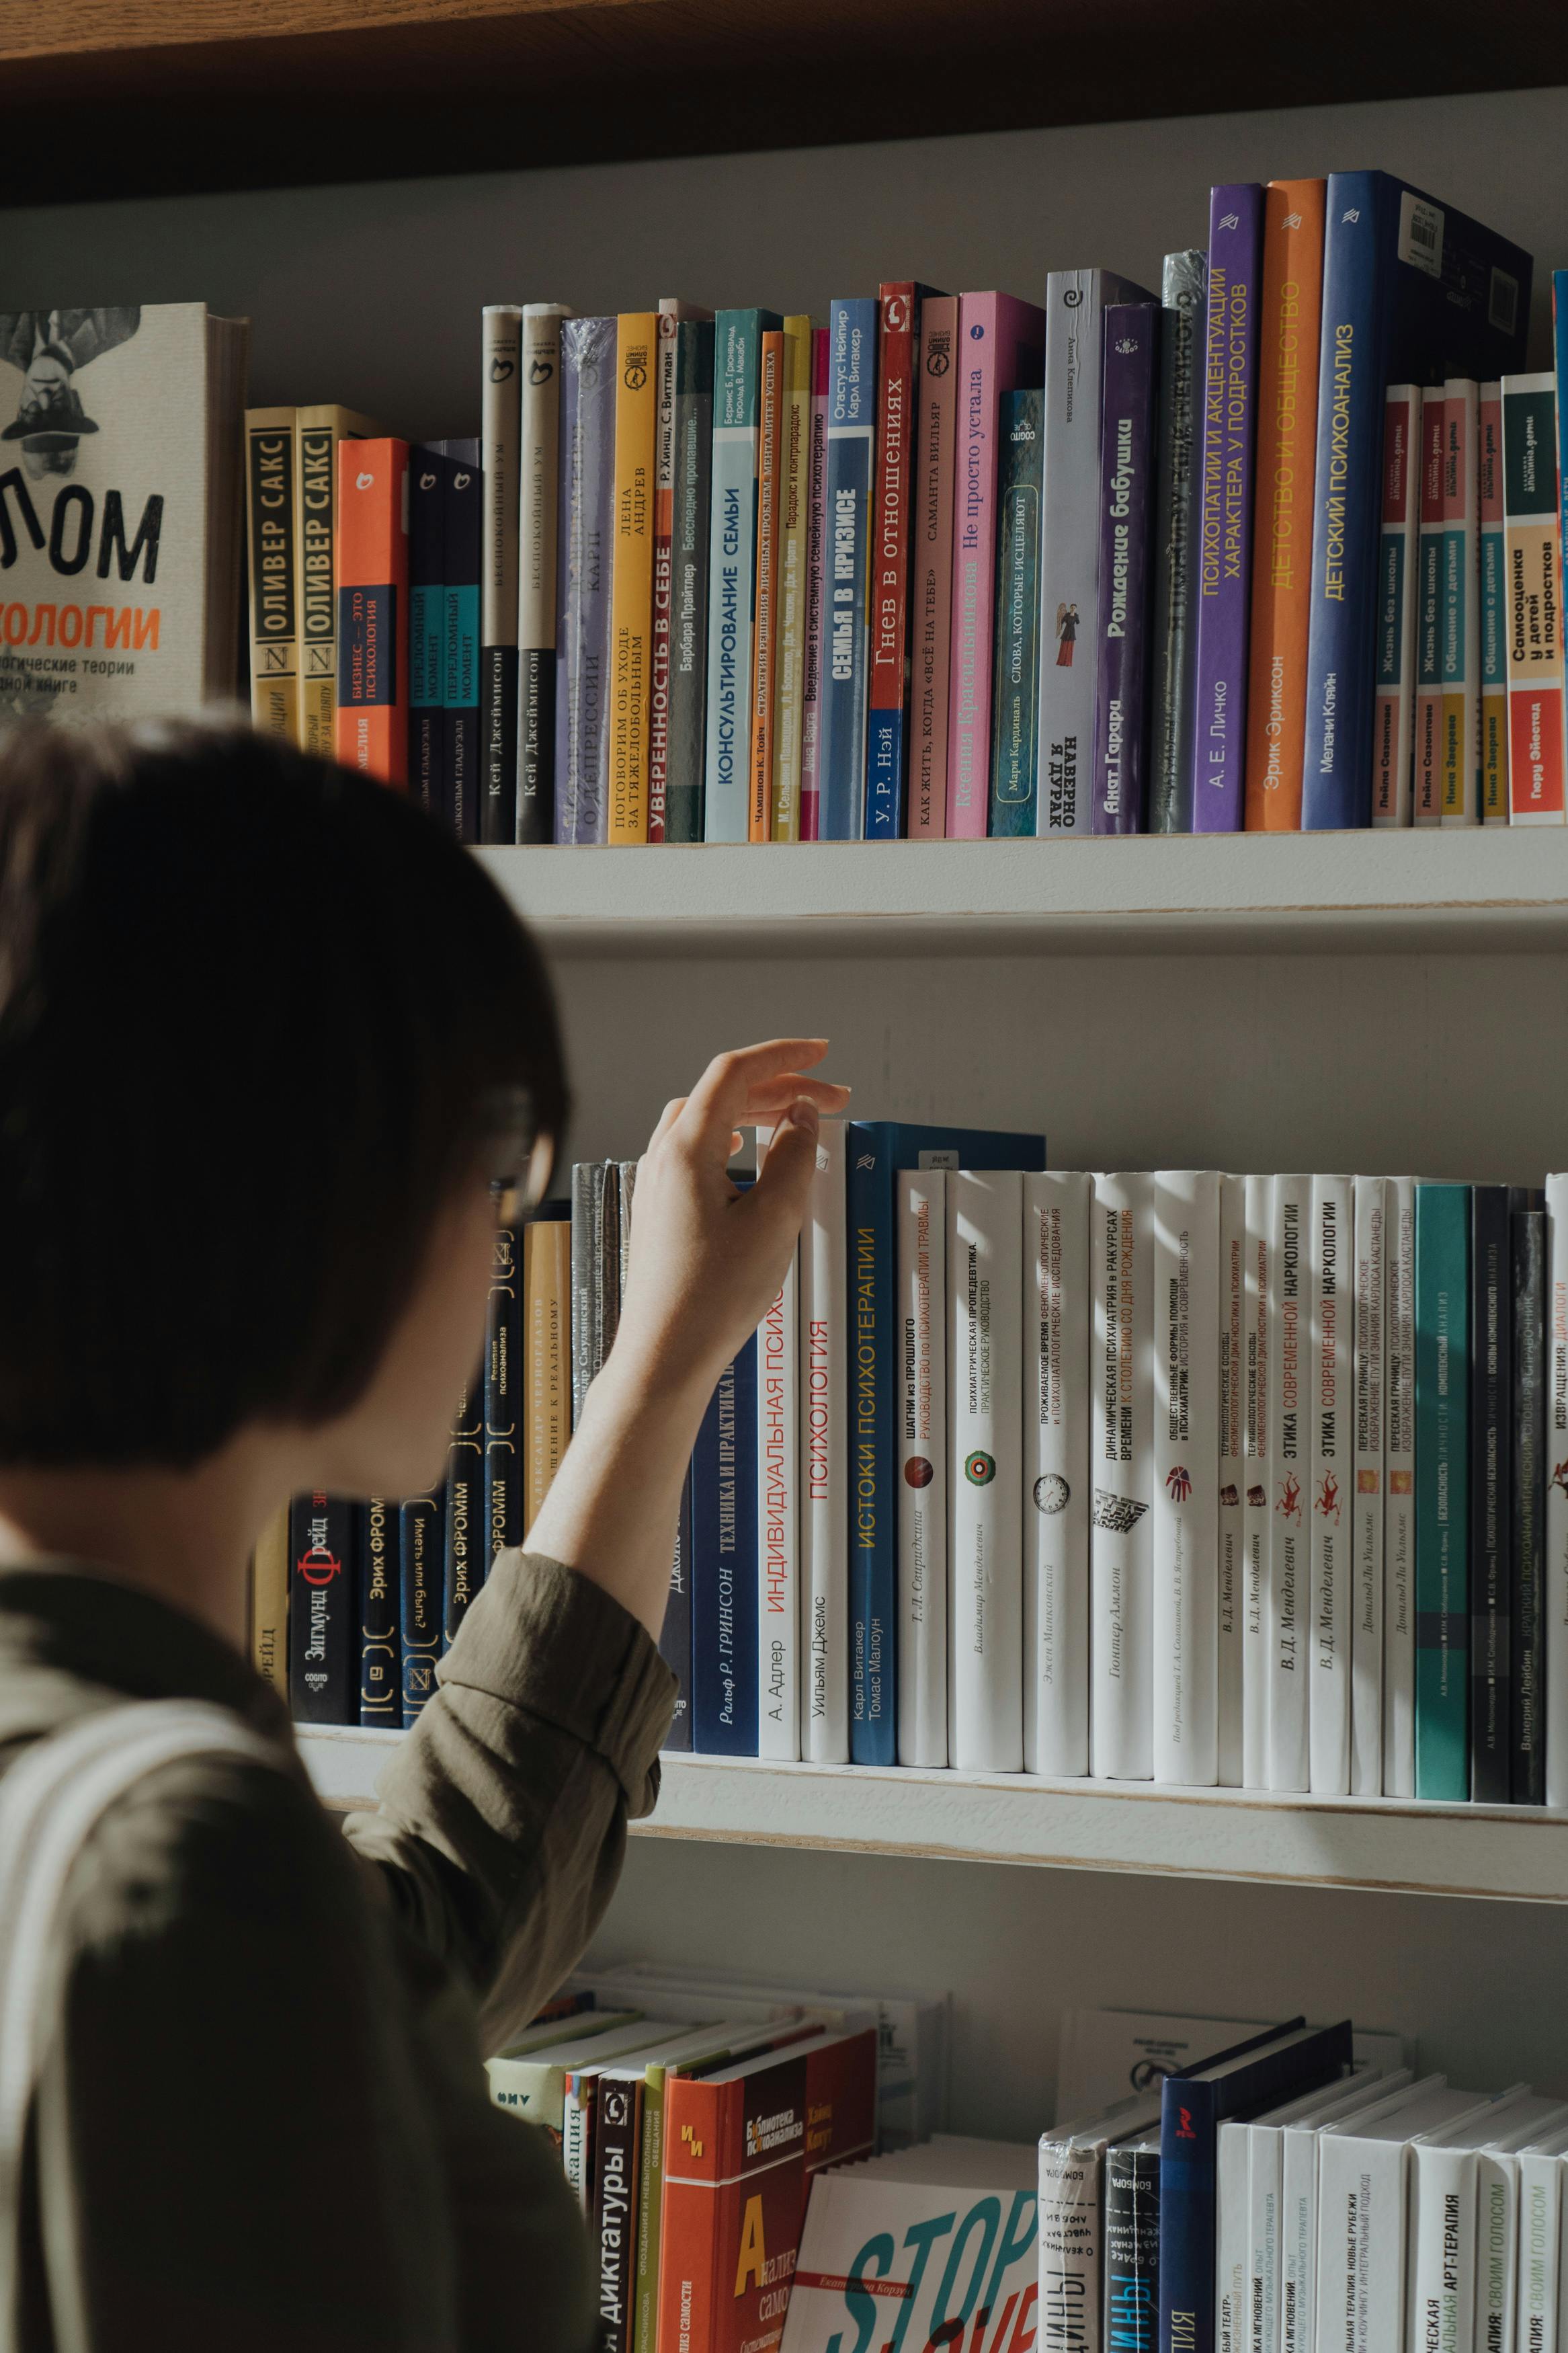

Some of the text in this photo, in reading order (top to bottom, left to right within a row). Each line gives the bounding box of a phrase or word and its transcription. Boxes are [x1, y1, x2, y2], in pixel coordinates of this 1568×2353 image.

[724, 326, 739, 424] Бернис Б. Грюнвальд
[1225, 284, 1247, 578] ХАРАКТЕРА У ПОДРОСТКОВ
[963, 369, 985, 549] Не просто устала
[1202, 268, 1227, 596] ПСИХОПАТИИ И АКЦЕНТУАЦИИ
[1272, 281, 1300, 589] ДЕТСТВО И ОБЩЕСТВО
[1324, 324, 1352, 600] ДЕТСКИЙ ПСИХОАНАЛИЗ
[258, 440, 288, 631] ОЛИВЕР САКС
[493, 444, 505, 587] БЕСПОКОЙНЫЙ УМ
[757, 352, 776, 717] СТРАТЕГИЯ РЕШЕНИЯ ЛИЧНЫХ ПРОБЛЕМ. МЕНТАЛИТЕТ УСПЕХА
[876, 378, 902, 665] Гнев в отношениях
[1107, 419, 1134, 637] Рождение бабушки
[1447, 540, 1458, 590] детьми
[0, 603, 160, 650] ОЛОГИИ
[718, 489, 740, 785] КОНСУЛЬТИРОВАНИЕ СЕМЬИ
[833, 489, 856, 679] СЕМЬЯ В КРИЗИСЕ
[1012, 496, 1028, 684] СЛОВА, КОТОРЫЕ ИСЦЕЛЯЮТ
[1446, 606, 1458, 673] Общение
[1512, 549, 1526, 662] Самооценка
[1526, 594, 1542, 661] у детей
[1540, 541, 1555, 660] и подростков
[0, 655, 135, 676] огические теории
[36, 676, 77, 693] книге
[352, 592, 363, 699] БИЗНЕС ЭТО
[366, 600, 378, 699] ПСИХОЛОГИЯ
[650, 547, 670, 828] УВЕРЕННОСТЬ В СЕБЕ
[920, 569, 936, 826] КАК ЖИТЬ, КОГДА «ВСЁ НА ТЕБЕ»
[489, 651, 503, 796] Кей Джеймисон
[615, 627, 629, 828] ПОГОВОРИМ ОБ УХОДЕ
[628, 635, 643, 828] ЗА ТЯЖЕЛОБОЛЬНЫМ
[1104, 700, 1124, 814] Анат Гарари
[1319, 673, 1337, 773] Мелани Кляйн
[1528, 703, 1543, 799] Гюру Эйестад
[1048, 744, 1063, 828] Я ДУРАК
[1063, 736, 1077, 827] НАВЕРНО
[1106, 1210, 1118, 1271] РАКУРСАХ
[1120, 1209, 1133, 1277] РОЖДЕНИЯ
[1120, 1280, 1136, 1304] ДНЯ
[917, 1200, 932, 1439] РУКОВОДСТВО по ПСИХОТЕРАПИИ ТРАВМЫ
[967, 1241, 979, 1414] ПСИХИАТРИЧЕСКАЯ ПРОПЕДЕВТИКА.
[1106, 1284, 1118, 1361] ПСИХИАТРИЯ
[1120, 1307, 1134, 1323] СО
[1120, 1327, 1134, 1393] СТОЛЕТИЮ
[1282, 1204, 1298, 1458] ЭТИКА СОВРЕМЕННОЙ НАРКОЛОГИИ
[1320, 1201, 1337, 1458] ЭТИКА СОВРЕМЕННОЙ НАРКОЛОГИИ
[1555, 1282, 1567, 1341] ДИАЛОГИ
[810, 1320, 829, 1500] ПСИХОЛОГИЯ
[858, 1227, 877, 1548] ИСТОКИ ПСИХОТЕРАПИИ
[905, 1318, 916, 1439] ШАГНИ из ПРОШЛОГО
[1106, 1365, 1119, 1461] ДИНАМИЧЕСКАЯ
[1120, 1406, 1134, 1461] ВРЕМЕНИ
[718, 1381, 737, 1553] ТЕХНИКА И ПРАКТИКА
[767, 1378, 788, 1613] ИНДИВИДУАЛЬНАЯ
[296, 1517, 341, 1661] Зигмунд Фрейд
[411, 1517, 426, 1628] Иметь или быть?
[453, 1483, 469, 1604] Эрих ФРОММ
[812, 1597, 829, 1718] Уильям Джемс
[1280, 1537, 1297, 1671] В. Д. Менделевич
[853, 1622, 866, 1720] Карл Витакер
[868, 1618, 882, 1720] Томас Малоун
[642, 2110, 652, 2199] НЕВЫПОЛНЕННЫЕ
[652, 2110, 661, 2167] ОБЕЩАНИЯ
[1360, 2174, 1371, 2212] ПОДХОД
[600, 2147, 627, 2323] диктатуры
[641, 2212, 649, 2275] ОПОЗДАНИЯ
[1347, 2194, 1357, 2234] РУБЕЖИ
[1347, 2237, 1356, 2270] НОВЫЕ
[1359, 2214, 1369, 2286] ИНТЕГРАЛЬНЫЙ
[1444, 2194, 1459, 2290] АРТ-ТЕРАПИЯ
[1489, 2184, 1504, 2309] СВОИМ ГОЛОСОМ
[679, 2281, 692, 2331] самости
